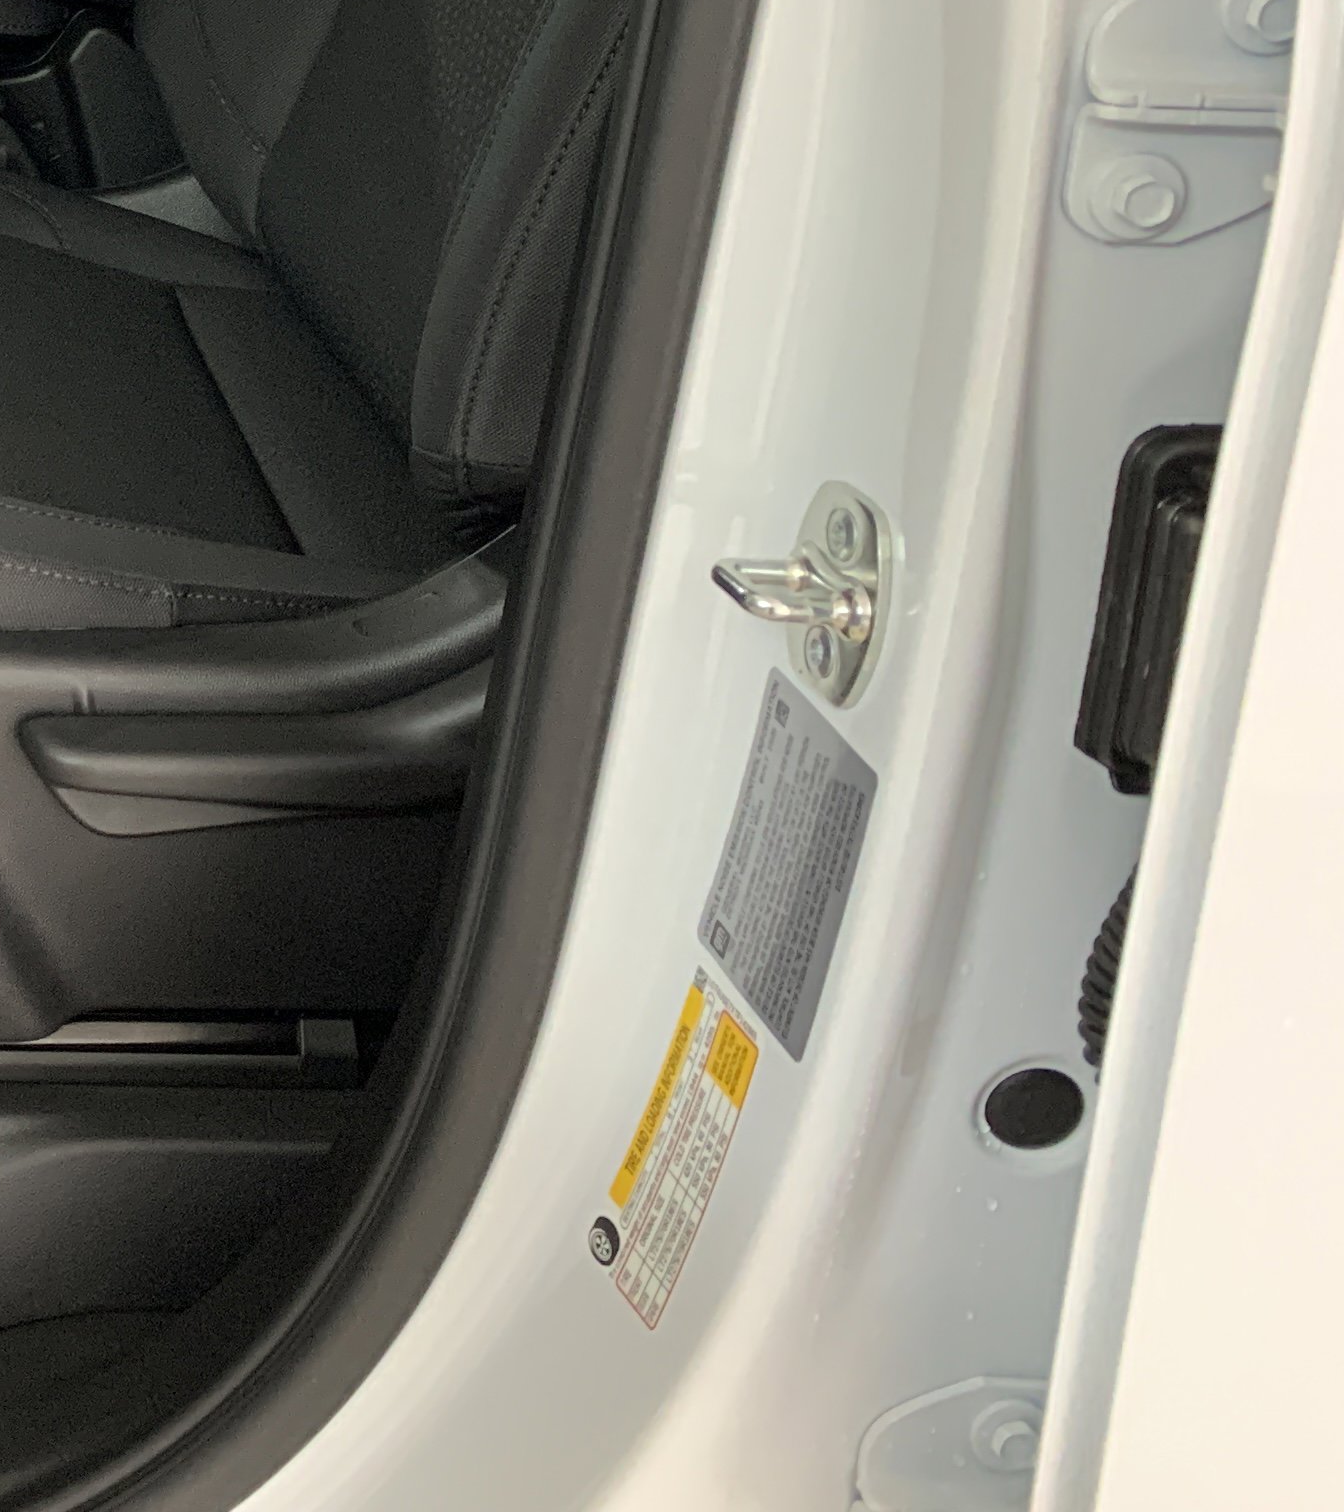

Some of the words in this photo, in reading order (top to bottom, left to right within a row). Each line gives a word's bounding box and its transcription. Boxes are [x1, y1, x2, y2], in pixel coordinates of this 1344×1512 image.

[624, 1150, 641, 1177] TIRE
[635, 1130, 649, 1154] AND
[643, 1087, 667, 1134] LOADING
[661, 1023, 691, 1090] INFORMATION
